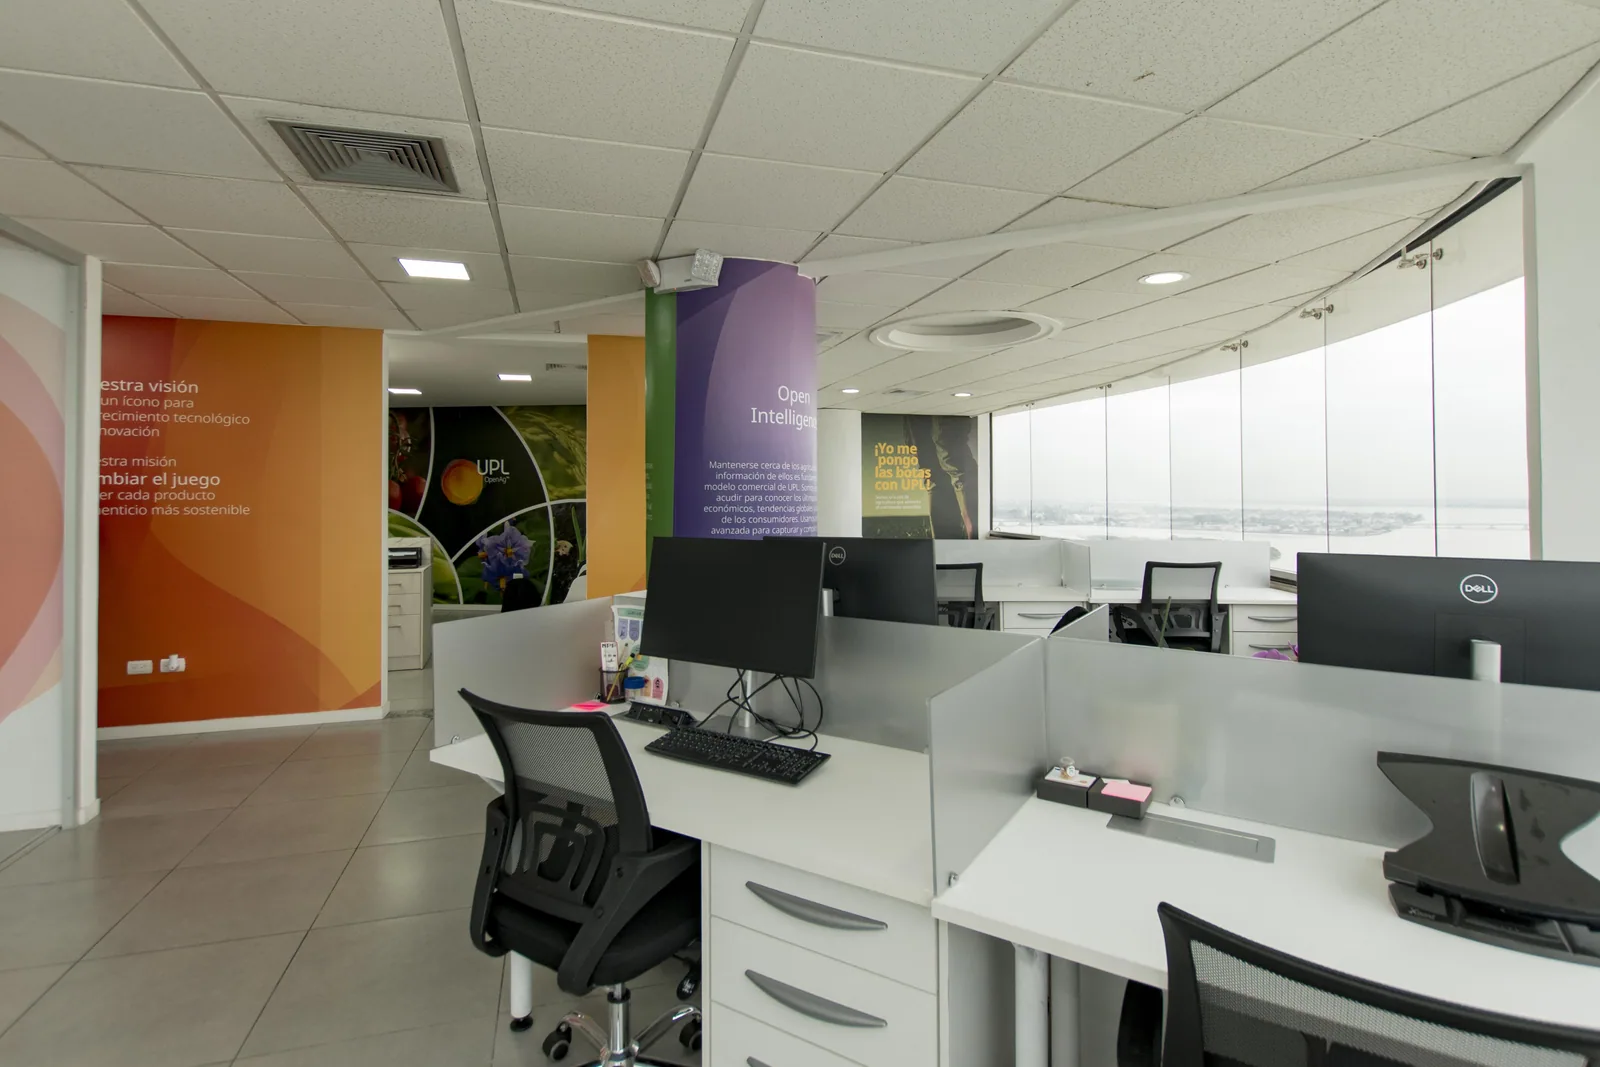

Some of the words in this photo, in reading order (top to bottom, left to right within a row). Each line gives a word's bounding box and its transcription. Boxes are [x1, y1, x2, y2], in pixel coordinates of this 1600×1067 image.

[148, 380, 199, 394] visión
[777, 385, 811, 407] Open
[163, 398, 194, 410] para
[173, 413, 251, 427] tecnológico
[874, 442, 895, 457] ¡Yo
[897, 445, 918, 455] me
[98, 457, 128, 467] stra
[132, 456, 177, 467] misión
[476, 459, 510, 476] UPL
[709, 460, 759, 470] Mantenerse
[760, 462, 781, 470] cerca
[781, 461, 791, 470] de
[877, 455, 919, 469] pongo
[715, 471, 765, 481] información
[766, 472, 777, 481] de
[777, 472, 793, 481] ellos
[875, 466, 893, 478] las
[895, 466, 931, 478] botas
[152, 472, 167, 485] el
[171, 473, 221, 489] juego
[704, 482, 736, 491] modelo
[737, 482, 776, 491] comercial
[777, 482, 787, 491] de
[875, 480, 898, 490] con
[901, 478, 931, 490] UPL!
[117, 489, 150, 501] cada
[153, 490, 216, 503] producto
[715, 494, 743, 502] acudir
[744, 494, 763, 504] para
[98, 504, 148, 516] enticio
[151, 504, 180, 515] más
[183, 504, 251, 516] sostenible
[703, 504, 756, 514] económicos,
[756, 504, 796, 514] tendencias
[721, 515, 733, 524] de
[734, 515, 747, 524] los
[710, 526, 750, 536] avanzada
[751, 527, 770, 536] para
[771, 527, 799, 536] capturar
[1464, 584, 1495, 593] DELL
